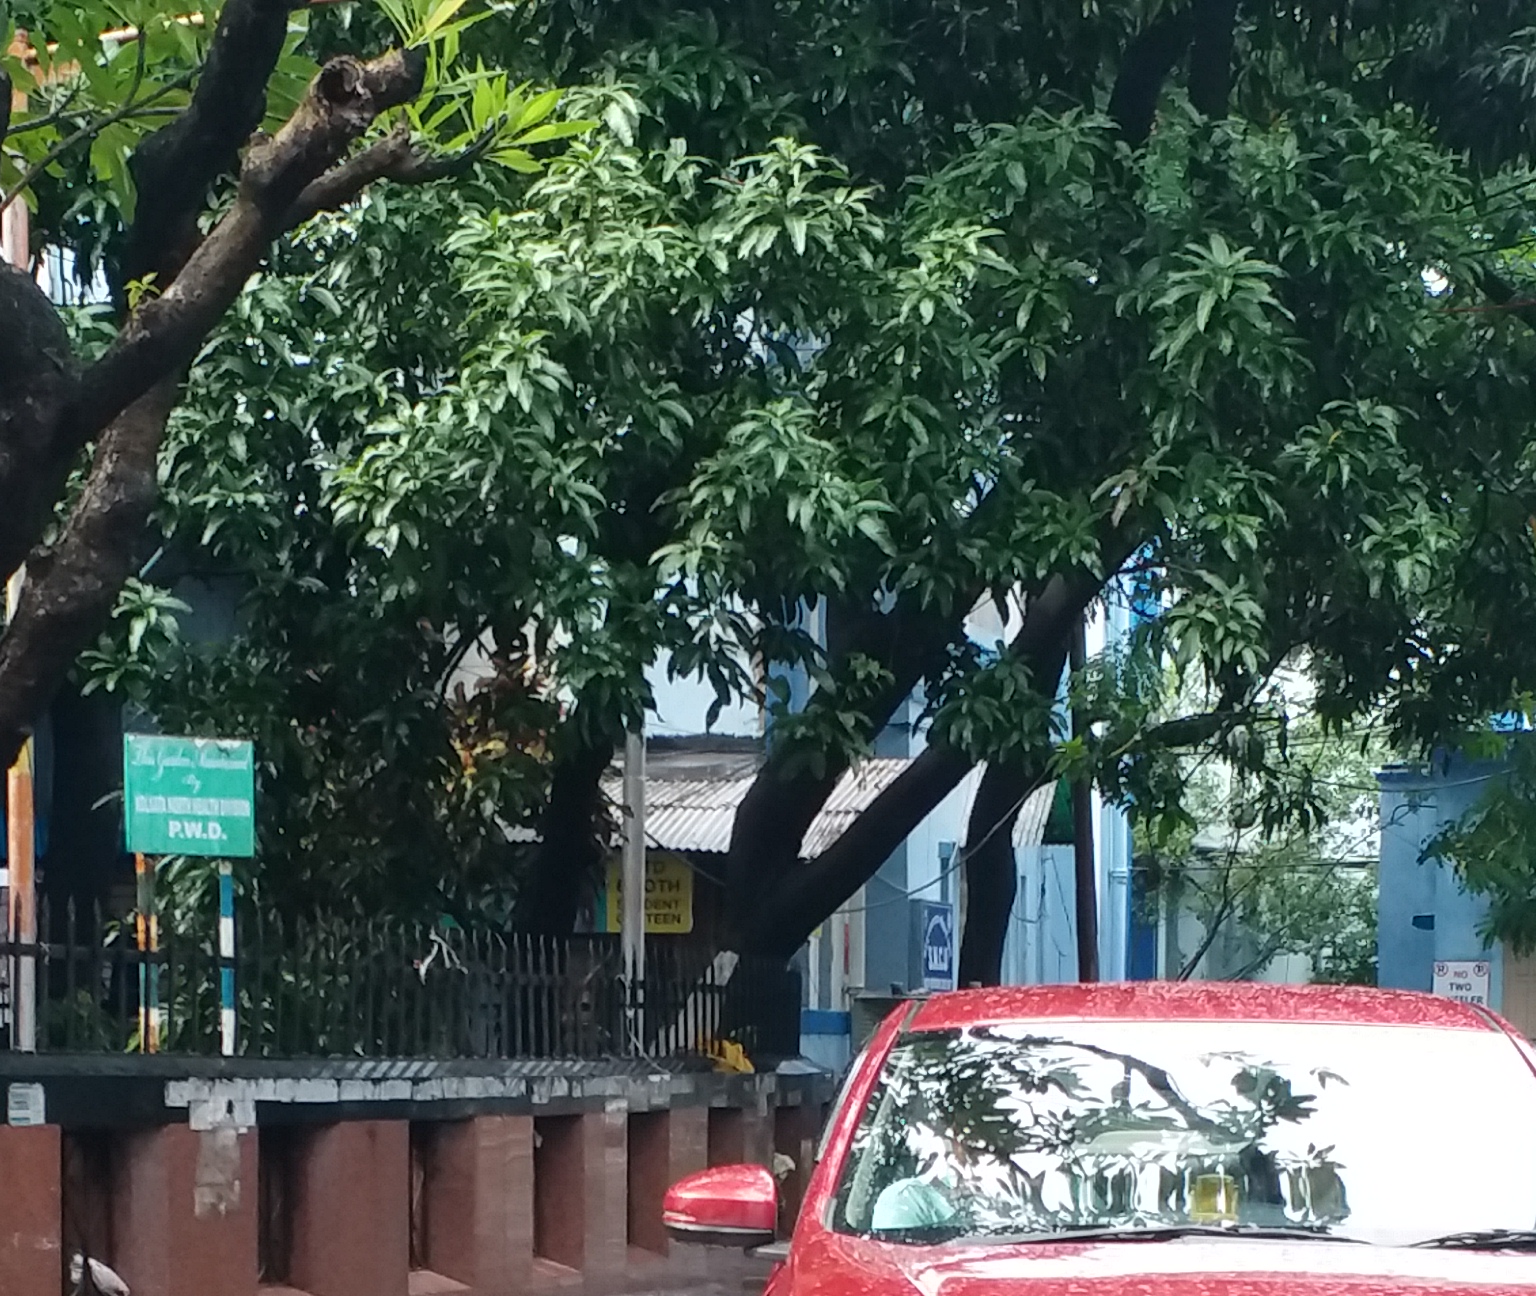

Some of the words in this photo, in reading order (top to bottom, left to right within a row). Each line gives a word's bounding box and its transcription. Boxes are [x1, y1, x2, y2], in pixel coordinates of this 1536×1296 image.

[168, 820, 228, 840] P.W.D.
[1454, 970, 1468, 979] NO
[1449, 982, 1472, 991] TWO
